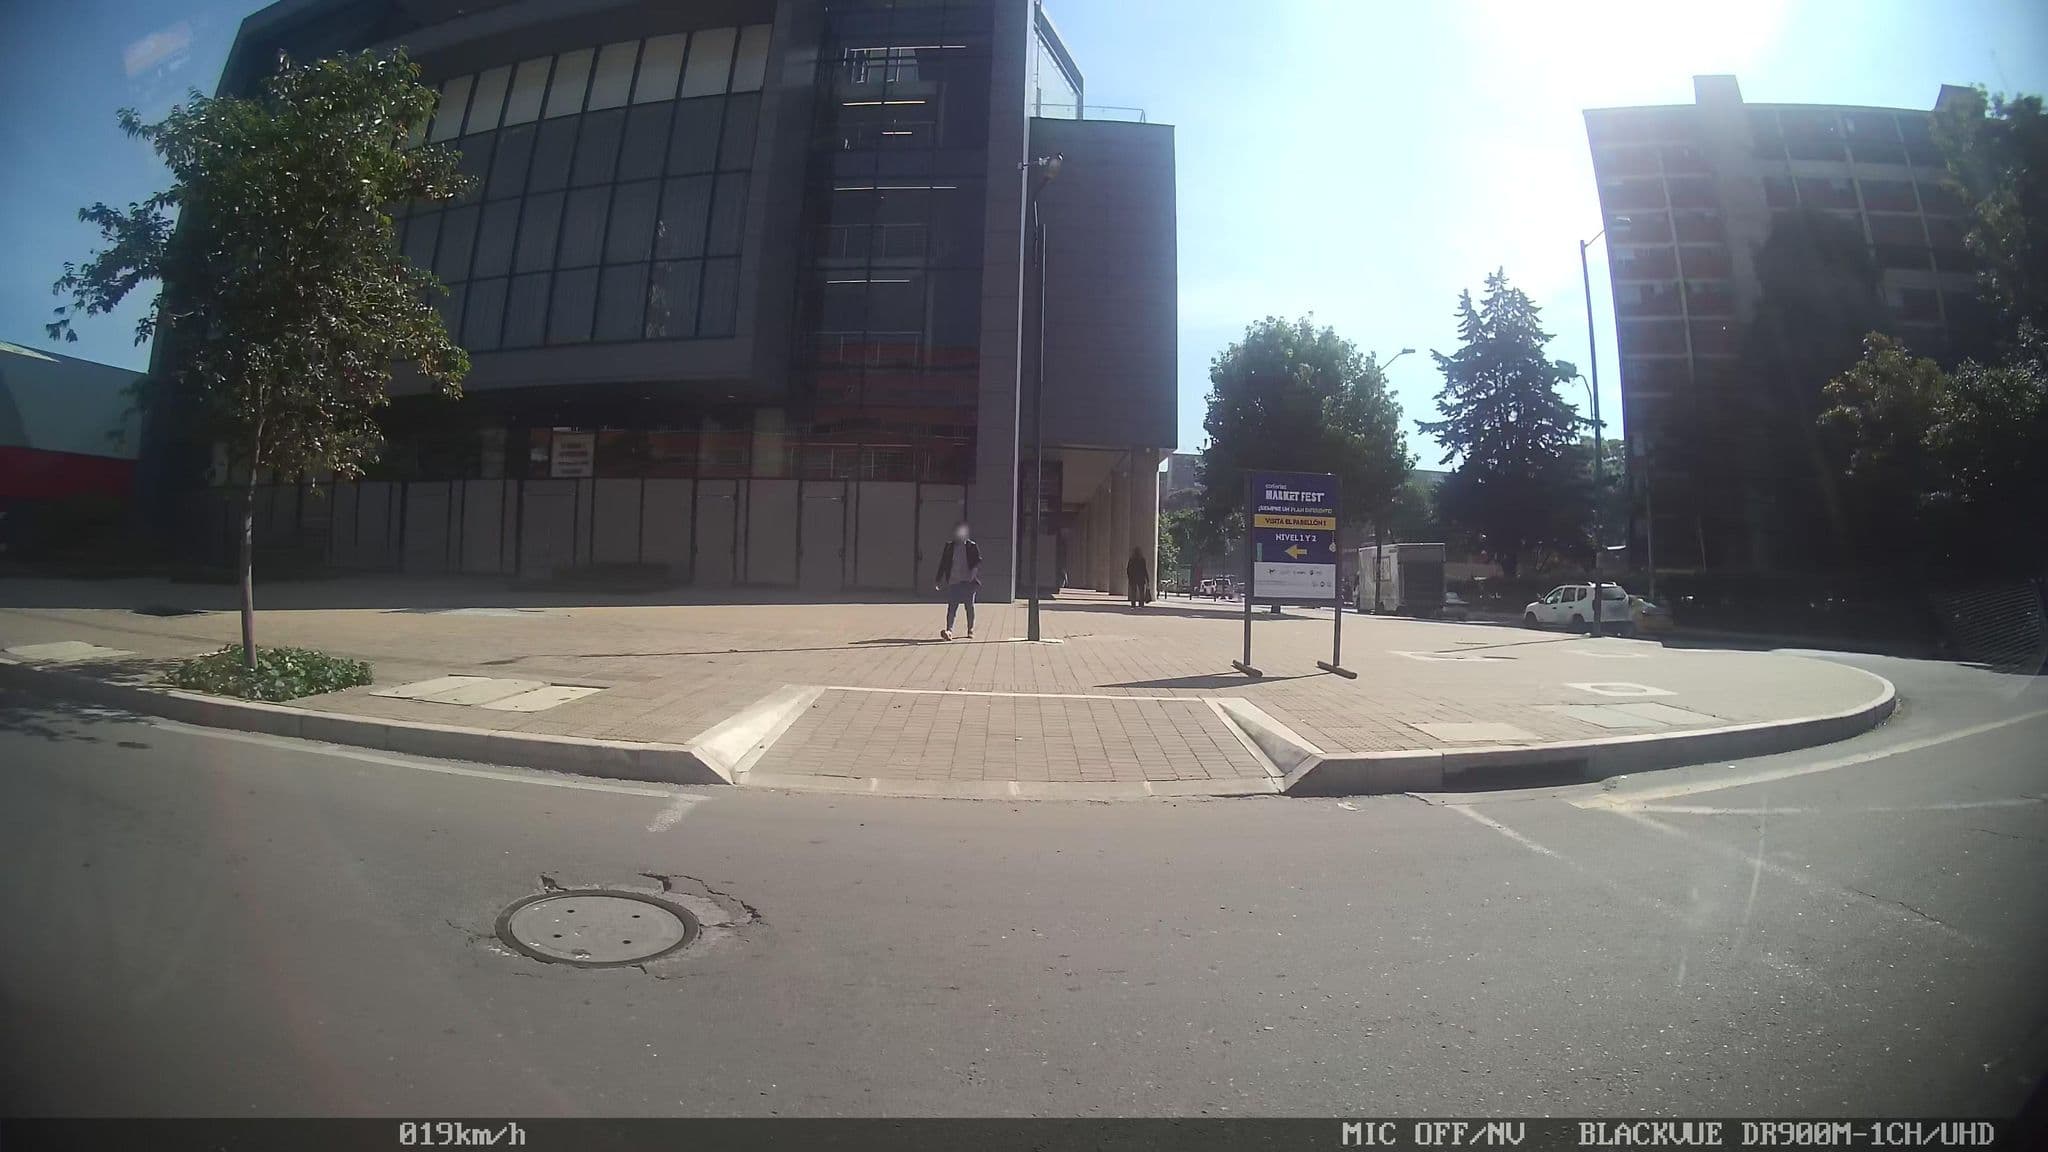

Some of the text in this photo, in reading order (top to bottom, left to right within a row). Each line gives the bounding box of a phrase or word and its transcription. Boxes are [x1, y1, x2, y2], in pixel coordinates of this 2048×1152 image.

[1265, 490, 1325, 502] MARKET FEST
[1292, 518, 1323, 526] PABELLÓN
[1275, 533, 1299, 541] NIVEL
[1300, 534, 1304, 542] 1
[1305, 534, 1311, 542] Y
